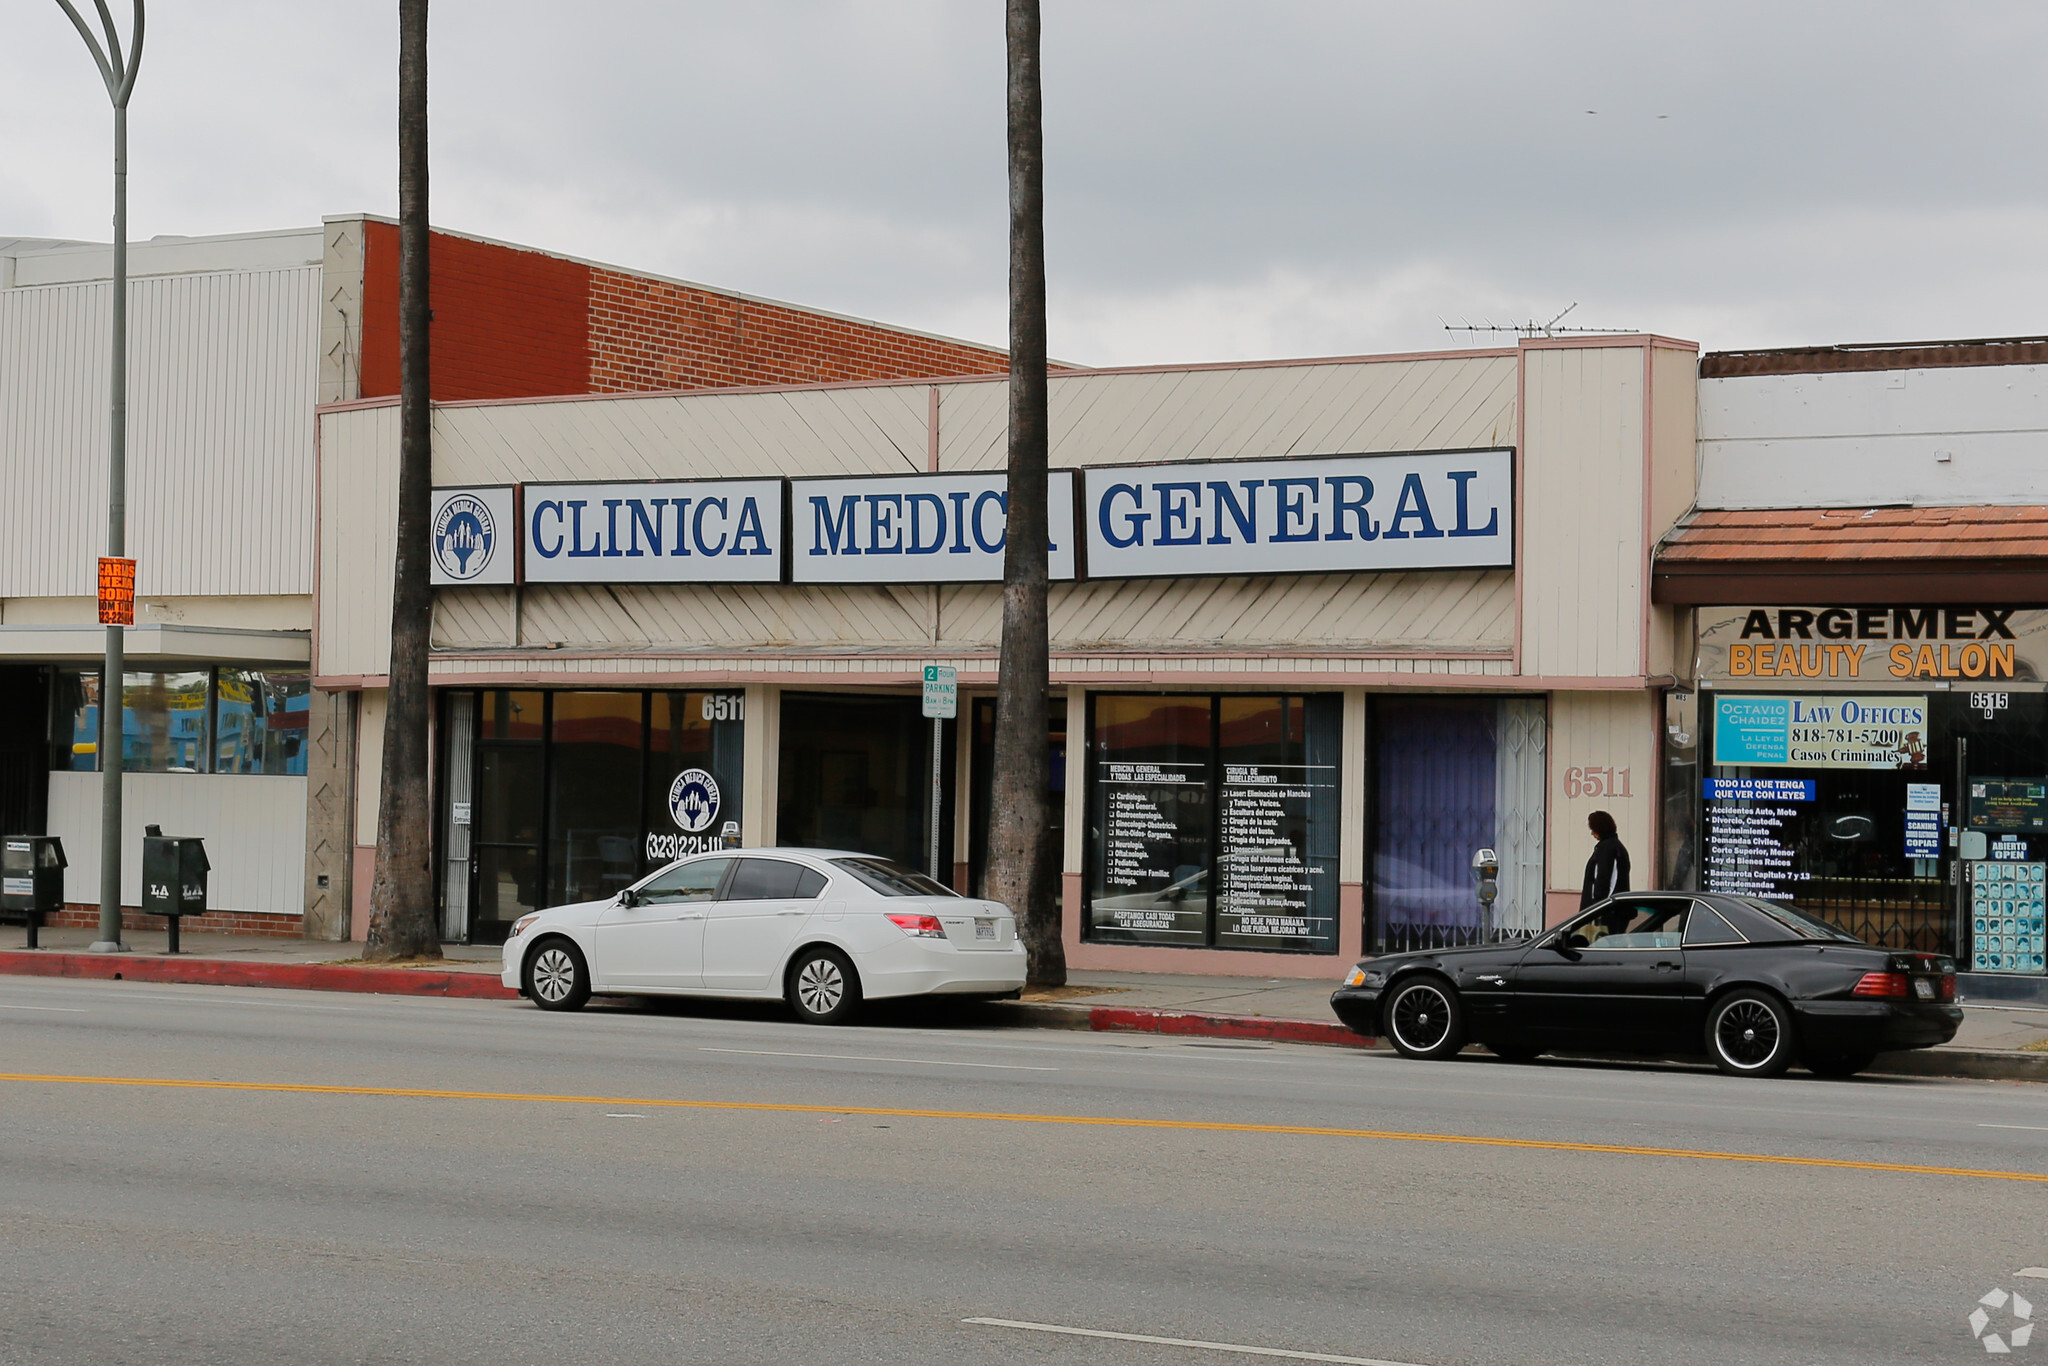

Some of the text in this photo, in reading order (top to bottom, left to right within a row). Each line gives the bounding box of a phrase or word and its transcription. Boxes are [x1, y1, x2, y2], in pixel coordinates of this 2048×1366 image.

[437, 501, 492, 537] CLINICA MEDICA GENERAL
[532, 470, 1498, 559] CLINICA MEDIC GENERAL
[1740, 608, 2017, 640] ARGEMEX
[1729, 644, 2015, 677] BEAUTY SALON
[928, 668, 934, 680] 2
[926, 684, 955, 694] PARKING
[1972, 692, 2006, 708] 6515
[702, 695, 744, 720] 6511
[1722, 703, 1785, 715] OCTAVIO
[1792, 701, 1922, 725] LAW OFFICES
[1986, 709, 1992, 718] D
[1729, 715, 1785, 725] CHAIDEZ
[1792, 728, 1898, 743] 818-781-5700
[1790, 748, 1900, 763] Casos Criminales
[1110, 765, 1161, 774] MEDICINA GENERAL
[1115, 773, 1132, 781] TODAS
[1134, 773, 1144, 781] LAS
[1145, 774, 1186, 782] ESPECIALIDADES
[1226, 775, 1278, 783] EMBELLECIMIENTO
[1564, 766, 1633, 798] 6511
[672, 772, 718, 804] CLINICA MEDICA GENERAL
[1714, 780, 1805, 790] TODO LO QUE TENGA
[1287, 790, 1311, 798] Manchas
[1714, 790, 1806, 800] QUE VER CON LEYES
[1136, 803, 1157, 811] General.
[1234, 799, 1258, 808] Tatuajes.
[1229, 809, 1254, 817] Escultura
[1255, 809, 1264, 817] del
[1712, 807, 1754, 815] Accidentes
[1755, 808, 1776, 817] Auto,
[1712, 817, 1783, 827] Divorcio, Custodia,
[1908, 822, 1937, 831] SCANING
[1712, 827, 1770, 836] Mantenimiento
[1711, 837, 1781, 847] Demandas Civiles,
[1907, 839, 1938, 848] COPIAS
[1992, 842, 2027, 851] ABIERTO
[1734, 848, 1769, 857] Superior,
[1770, 849, 1795, 857] Menor
[1995, 851, 2025, 860] OPEN
[1260, 856, 1285, 864] abdomen
[1711, 857, 1725, 865] Ley
[1737, 858, 1764, 866] Bienes
[1765, 858, 1791, 867] Raíces
[1710, 870, 1753, 878] Bancarrota
[1710, 879, 1775, 889] Contrademandas
[151, 884, 170, 896] LA
[183, 884, 203, 896] LA
[1758, 891, 1794, 900] Animales
[1114, 912, 1176, 921] ACEPTAMOS CASI TODAS
[1242, 917, 1250, 925] NO
[1266, 918, 1280, 926] PARA
[1121, 920, 1170, 929] LAS ASEGURANZAS
[1233, 924, 1310, 935] LO QUE PUEDA MEJORAR HOY
